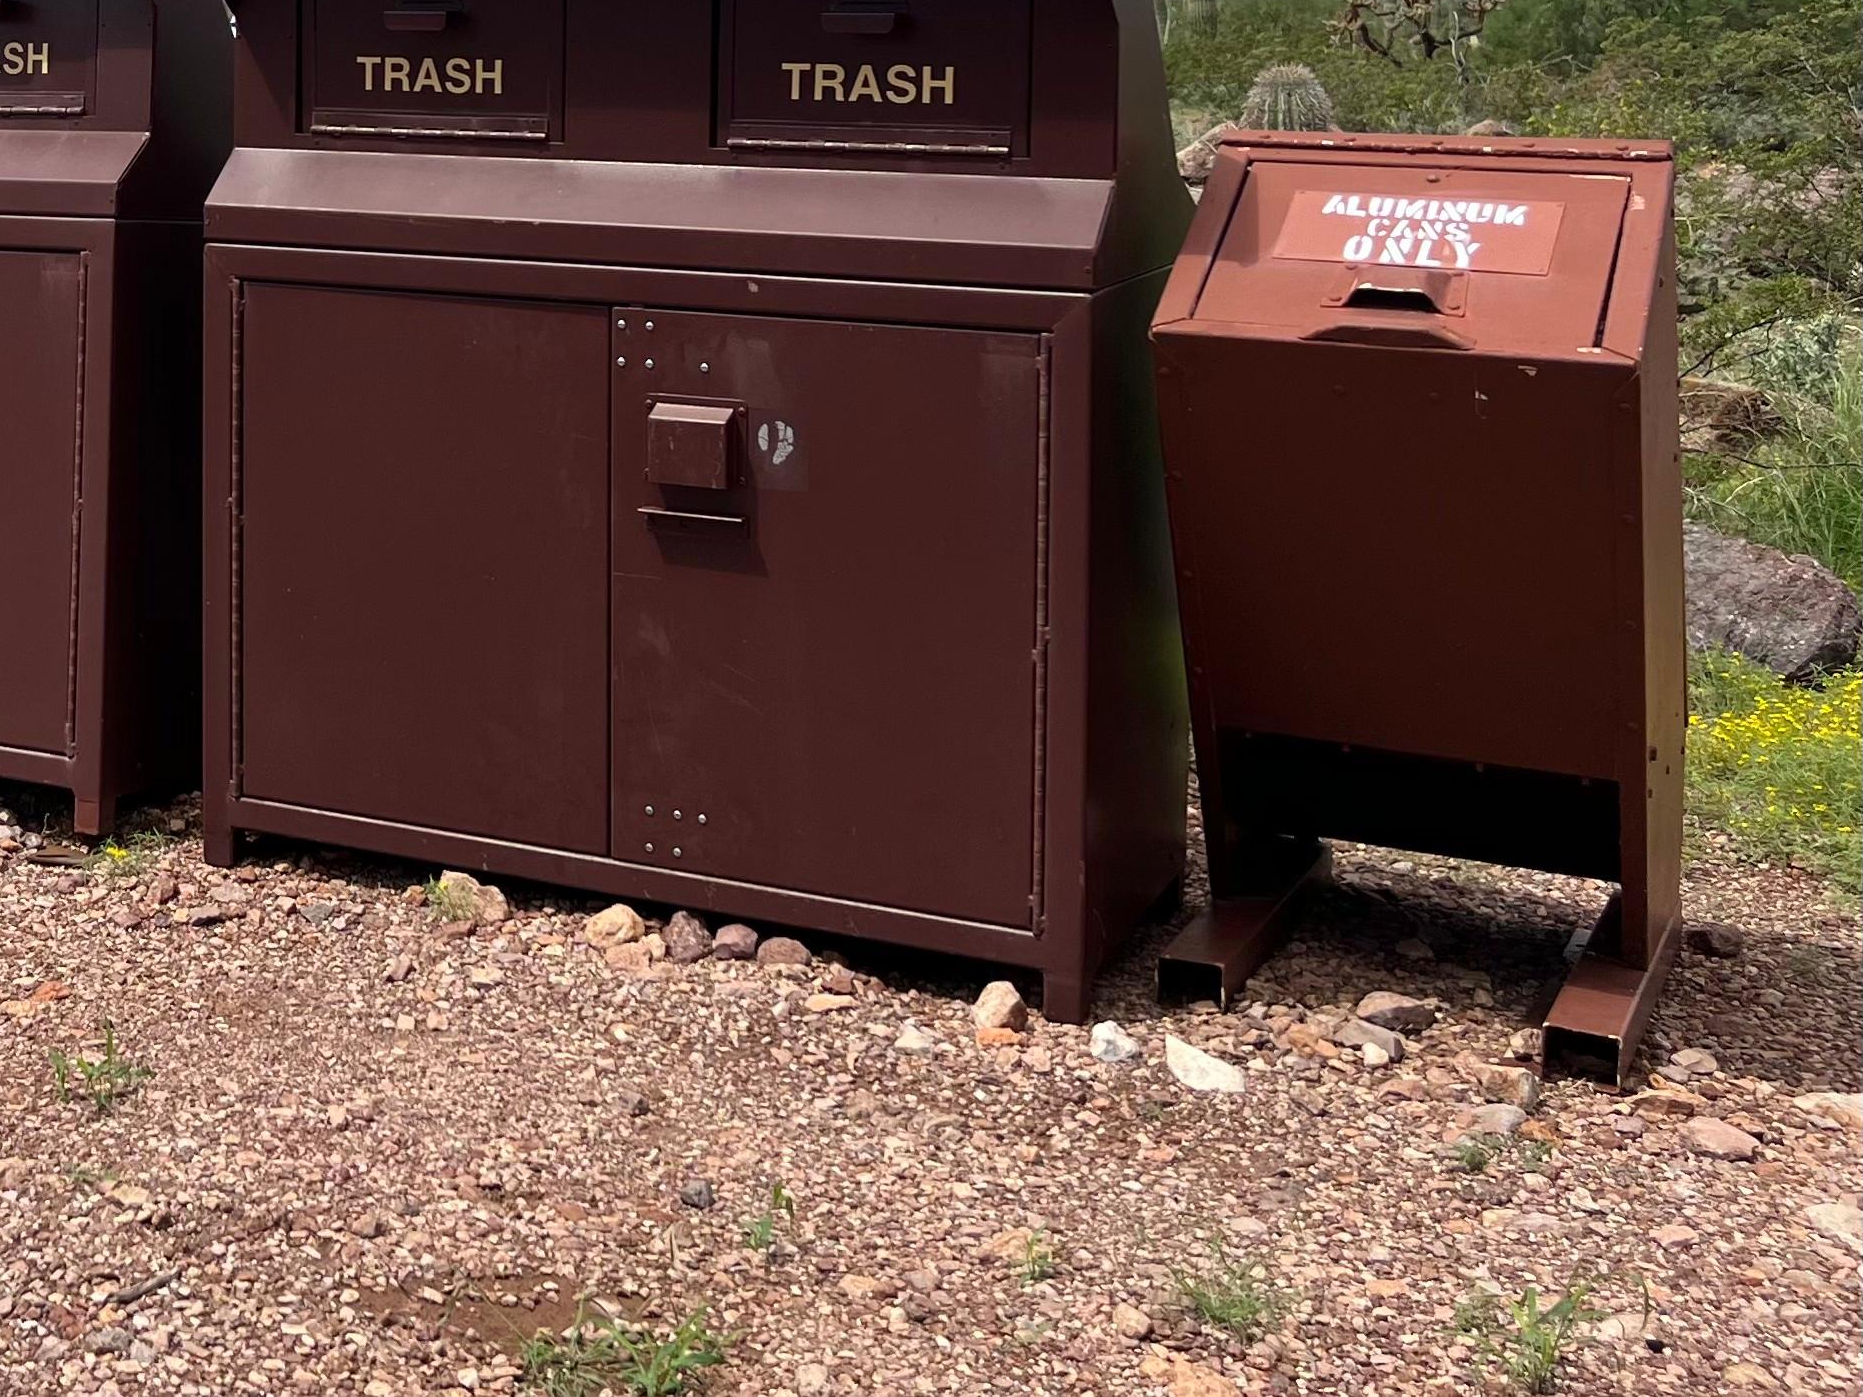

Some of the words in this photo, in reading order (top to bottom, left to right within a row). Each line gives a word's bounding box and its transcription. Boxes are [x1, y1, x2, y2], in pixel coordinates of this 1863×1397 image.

[356, 56, 503, 94] TRASH
[781, 62, 954, 104] TRASH
[1322, 195, 1528, 225] ALUMINUM
[1366, 219, 1470, 241] CANS
[1343, 235, 1480, 269] ONLY
